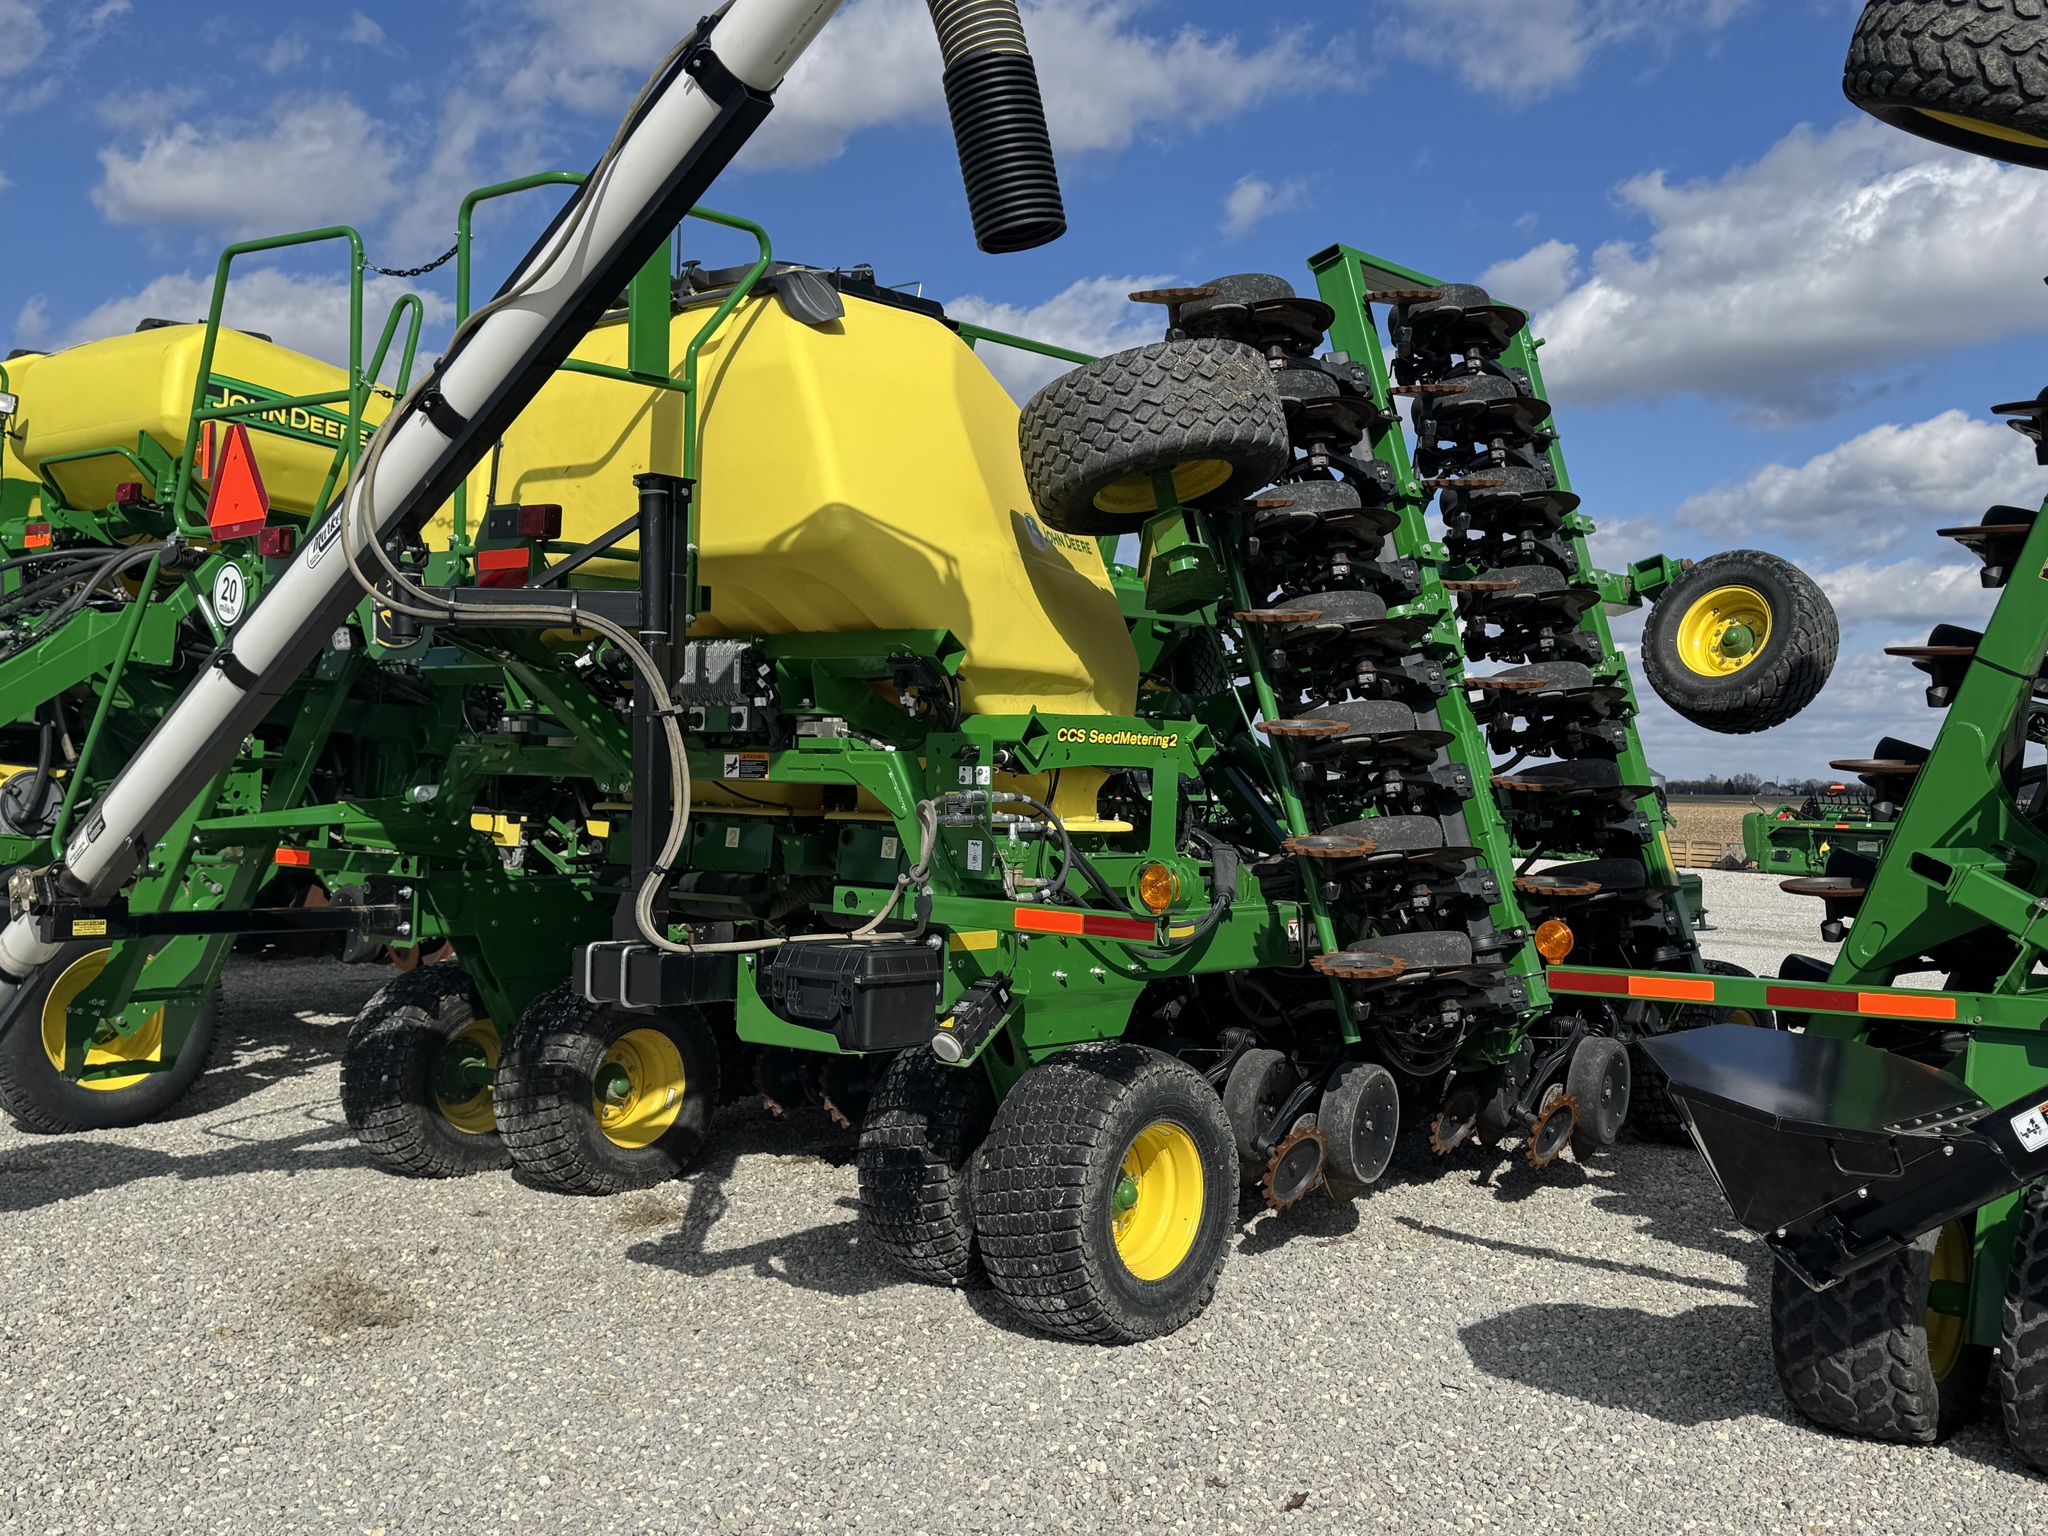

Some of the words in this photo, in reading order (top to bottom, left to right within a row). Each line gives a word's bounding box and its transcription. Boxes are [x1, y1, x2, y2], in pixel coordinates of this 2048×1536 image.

[1042, 527, 1065, 547] JOHN
[1063, 533, 1093, 555] DEERE
[221, 576, 237, 604] 20
[1057, 728, 1087, 743] CCS
[1088, 729, 1178, 749] SeedMetering2
[729, 829, 738, 846] 2
[884, 839, 894, 857] 3
